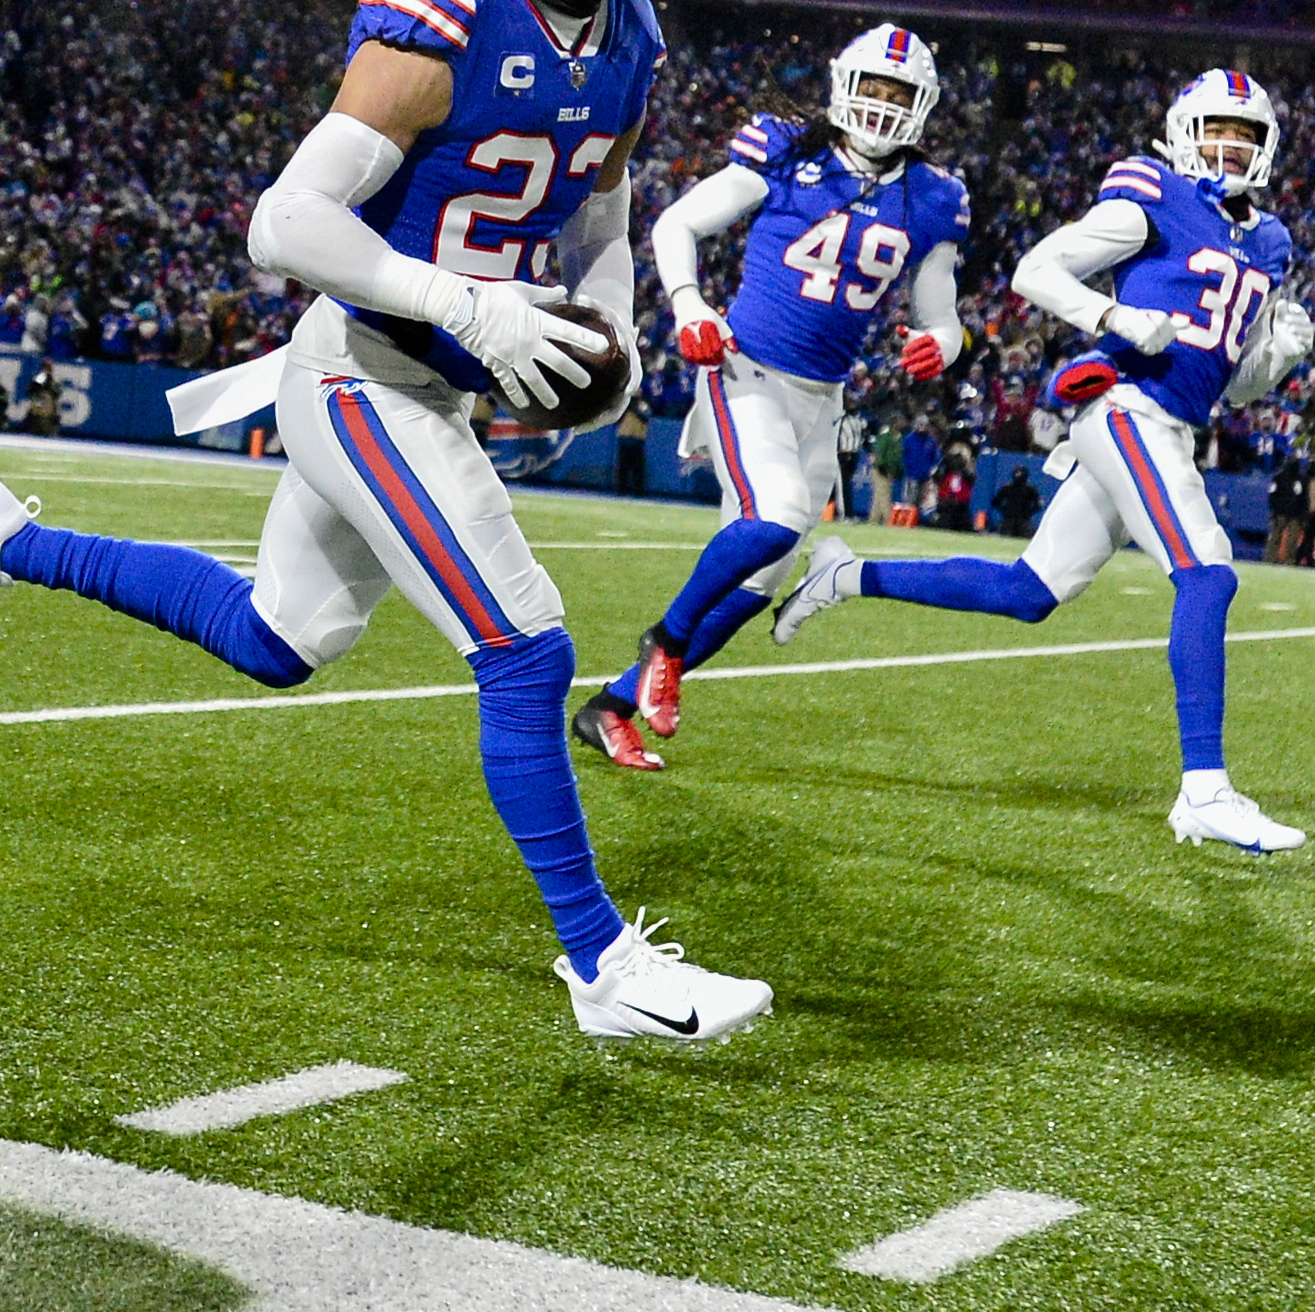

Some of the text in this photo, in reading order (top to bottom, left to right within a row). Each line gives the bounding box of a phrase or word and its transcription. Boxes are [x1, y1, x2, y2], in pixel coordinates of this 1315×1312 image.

[499, 54, 536, 89] C
[557, 106, 591, 122] BILLS
[783, 210, 911, 311] 49
[1170, 246, 1271, 366] 30
